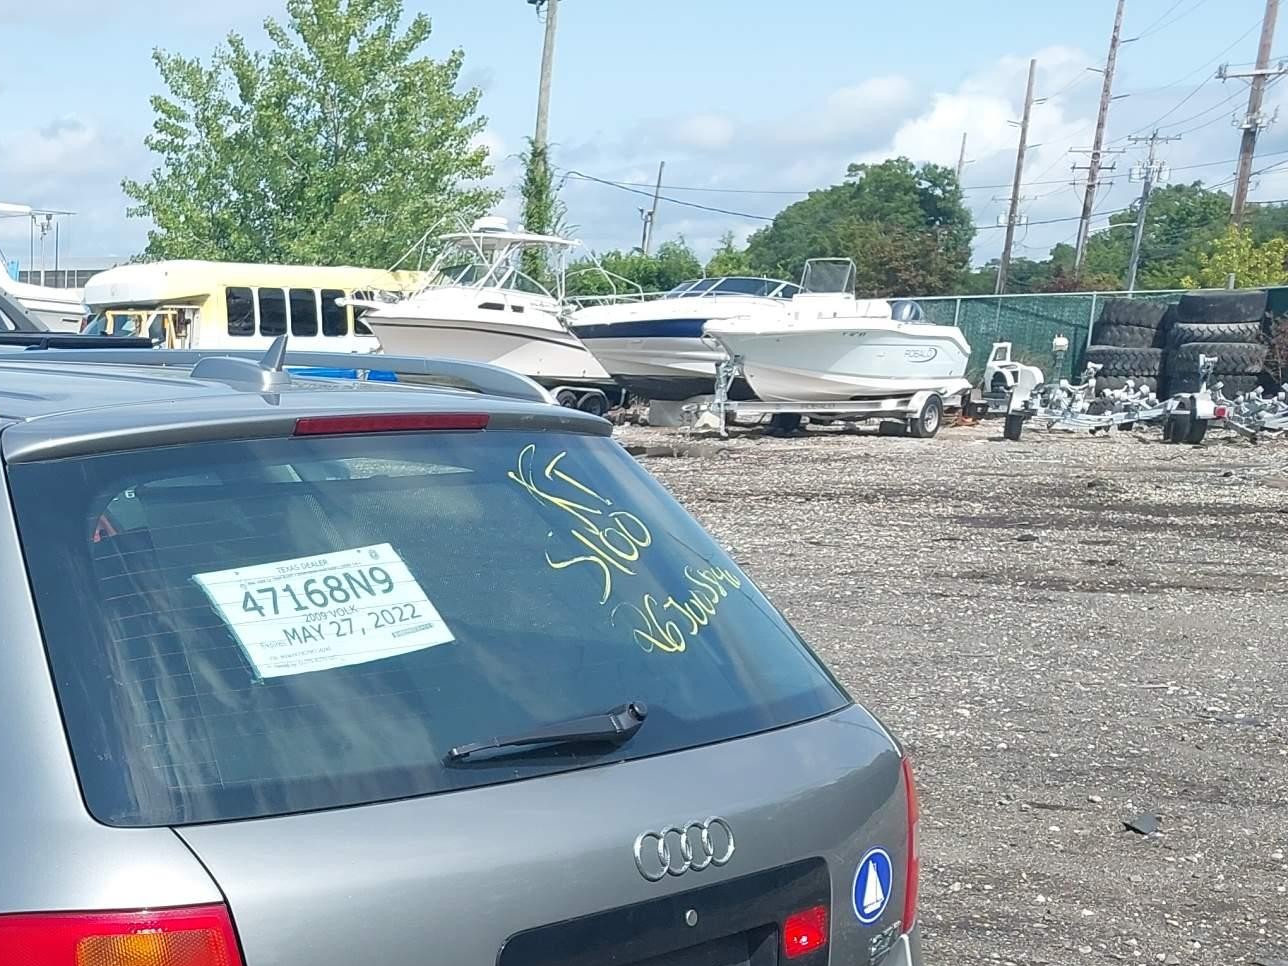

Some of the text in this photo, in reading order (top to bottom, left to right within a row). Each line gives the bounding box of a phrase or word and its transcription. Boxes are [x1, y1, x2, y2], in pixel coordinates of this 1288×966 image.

[242, 566, 394, 617] 47168N9
[305, 604, 358, 623] 2009 VOLK
[282, 624, 325, 647] MAY
[368, 603, 422, 630] 2022
